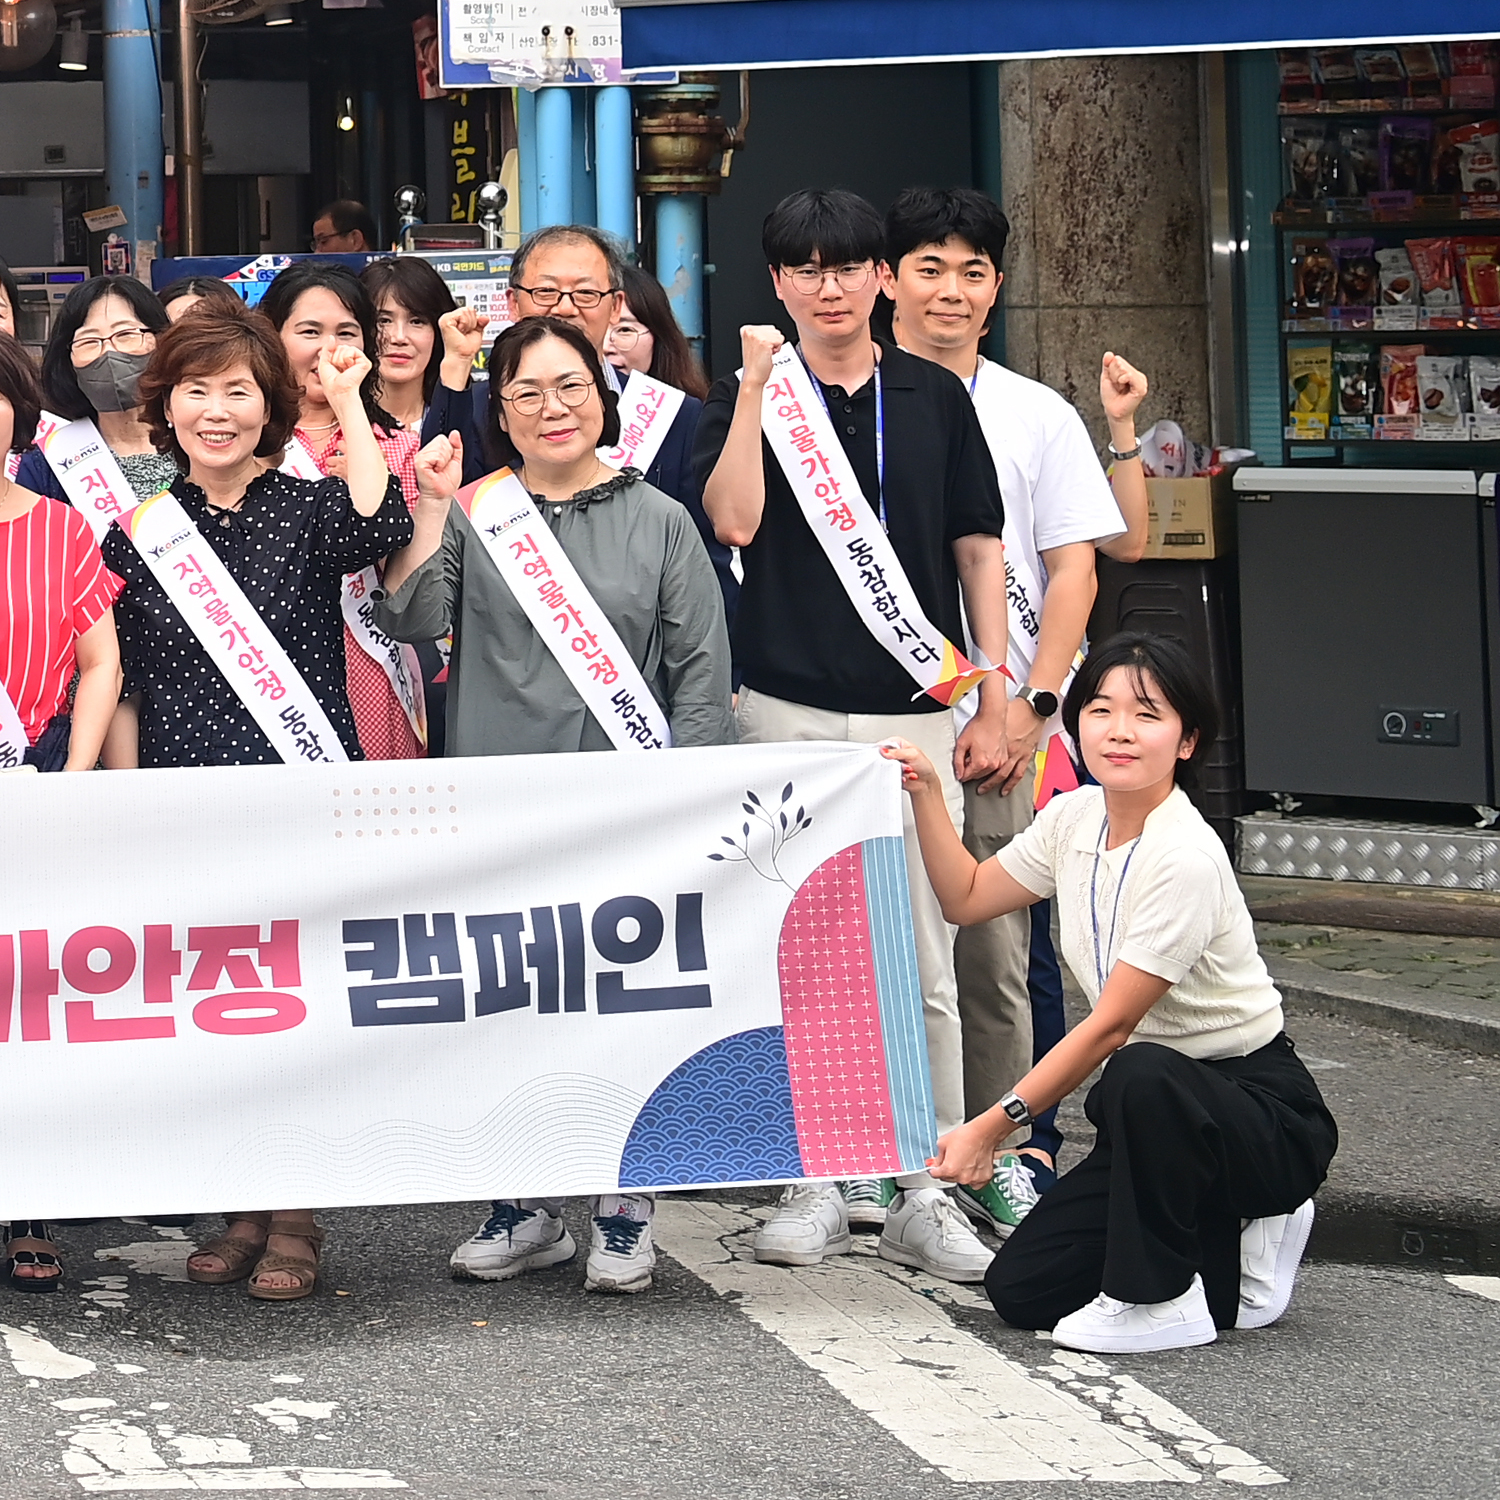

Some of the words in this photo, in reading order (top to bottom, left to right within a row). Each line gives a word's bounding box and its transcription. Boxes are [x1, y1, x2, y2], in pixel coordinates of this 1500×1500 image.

[766, 380, 858, 532] 지역물가안정
[845, 536, 940, 666] 동참합시다
[172, 552, 288, 702] 지역물가안정
[508, 531, 620, 685] 지역물가안정
[340, 892, 713, 1028] 캠페인
